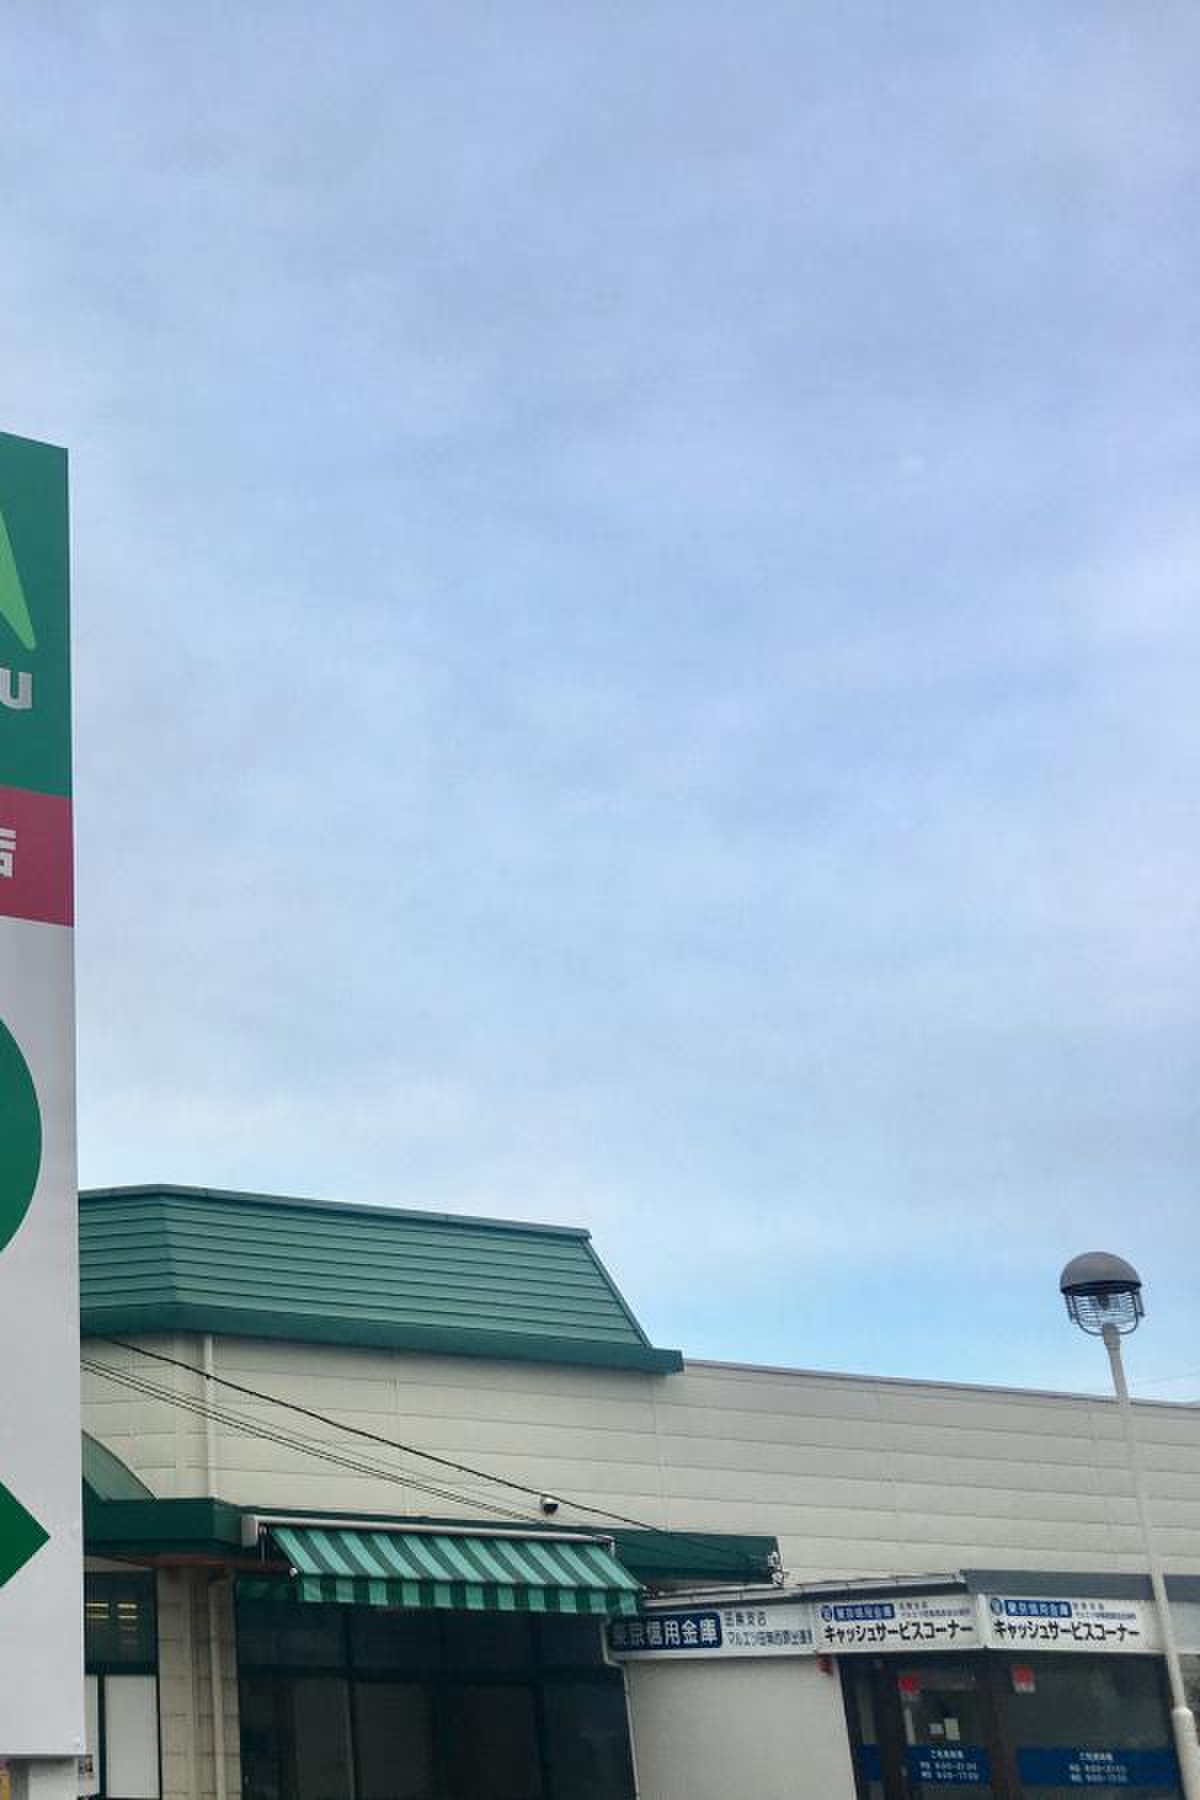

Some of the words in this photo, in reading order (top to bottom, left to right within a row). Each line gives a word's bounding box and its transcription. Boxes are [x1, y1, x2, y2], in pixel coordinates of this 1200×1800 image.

[824, 1619, 974, 1643] キャッシュサービスコーナー
[993, 1619, 1140, 1642] キャッシュサービスコーナー
